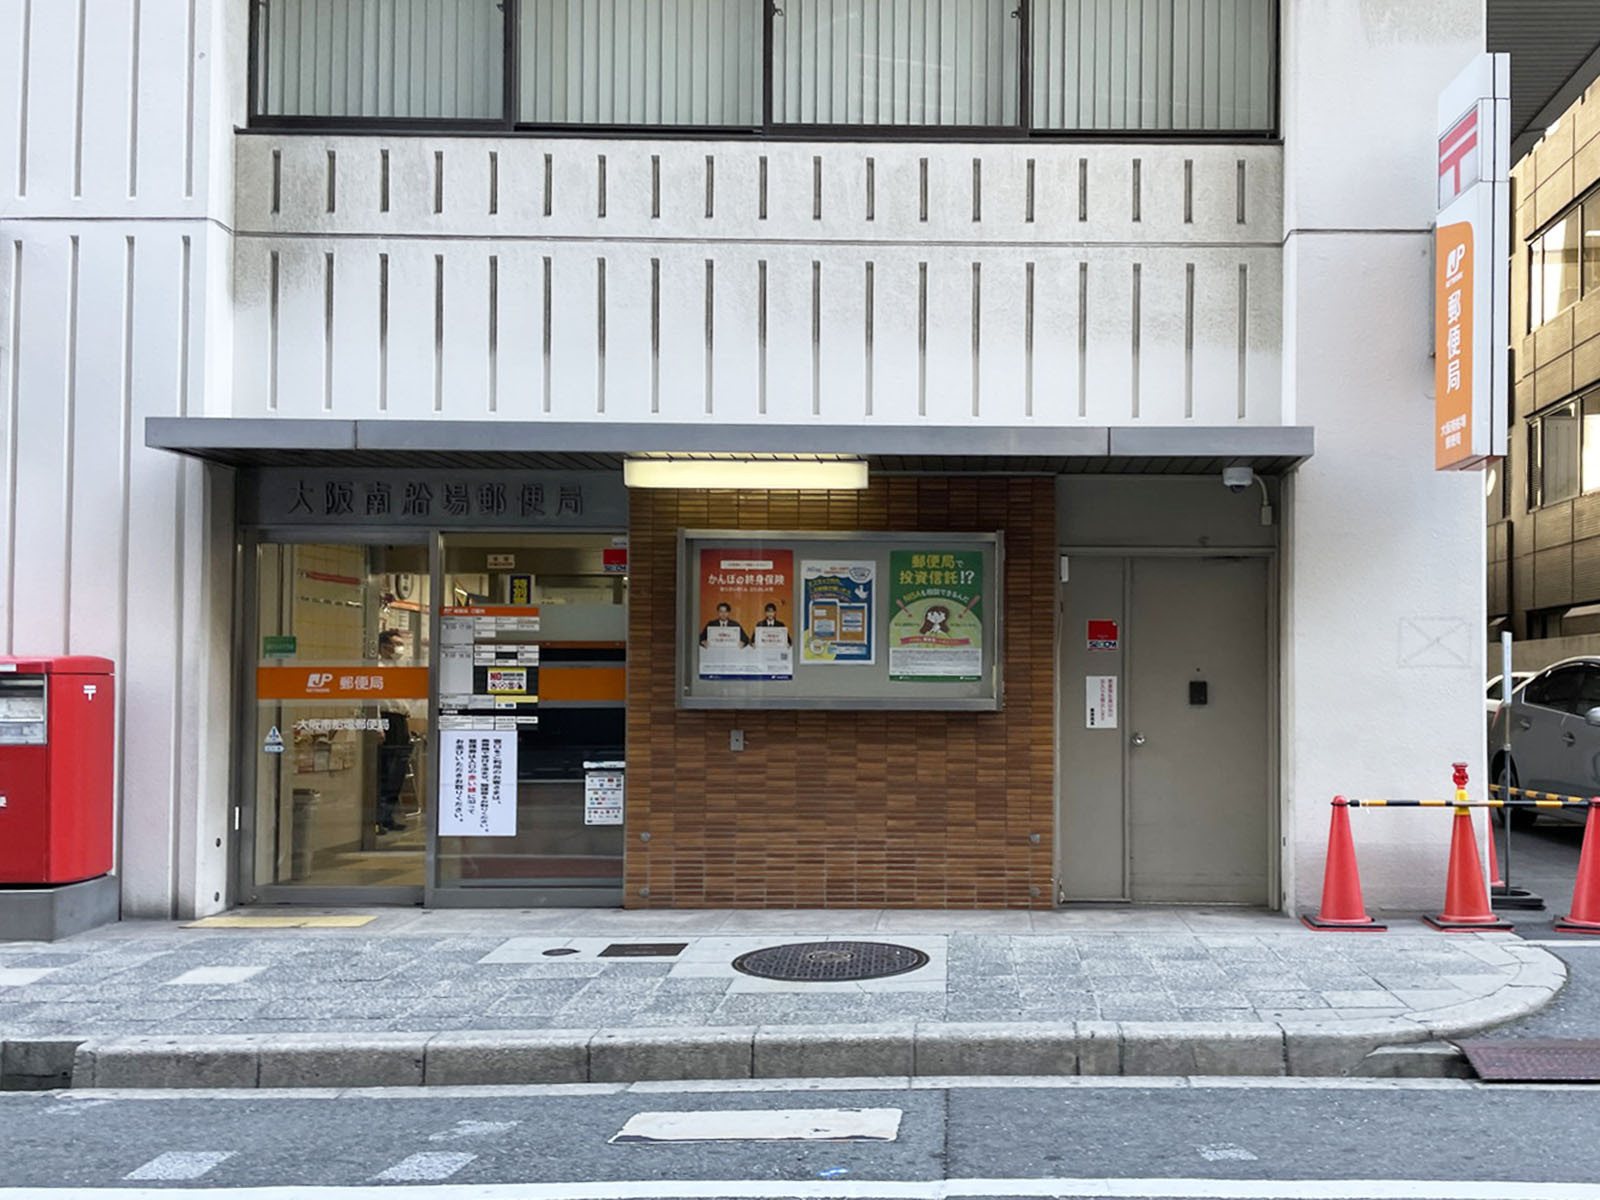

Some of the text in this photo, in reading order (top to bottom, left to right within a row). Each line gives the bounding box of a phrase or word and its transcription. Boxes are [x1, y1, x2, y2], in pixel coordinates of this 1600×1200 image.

[1447, 289, 1461, 393] 郵便局
[287, 480, 584, 517] 大阪南船場郵便局
[911, 554, 965, 569] 郵便局で
[899, 570, 976, 585] 投資信託!?
[307, 673, 384, 690] JP 郵便局
[297, 719, 390, 731] 大阪南船場郵便局
